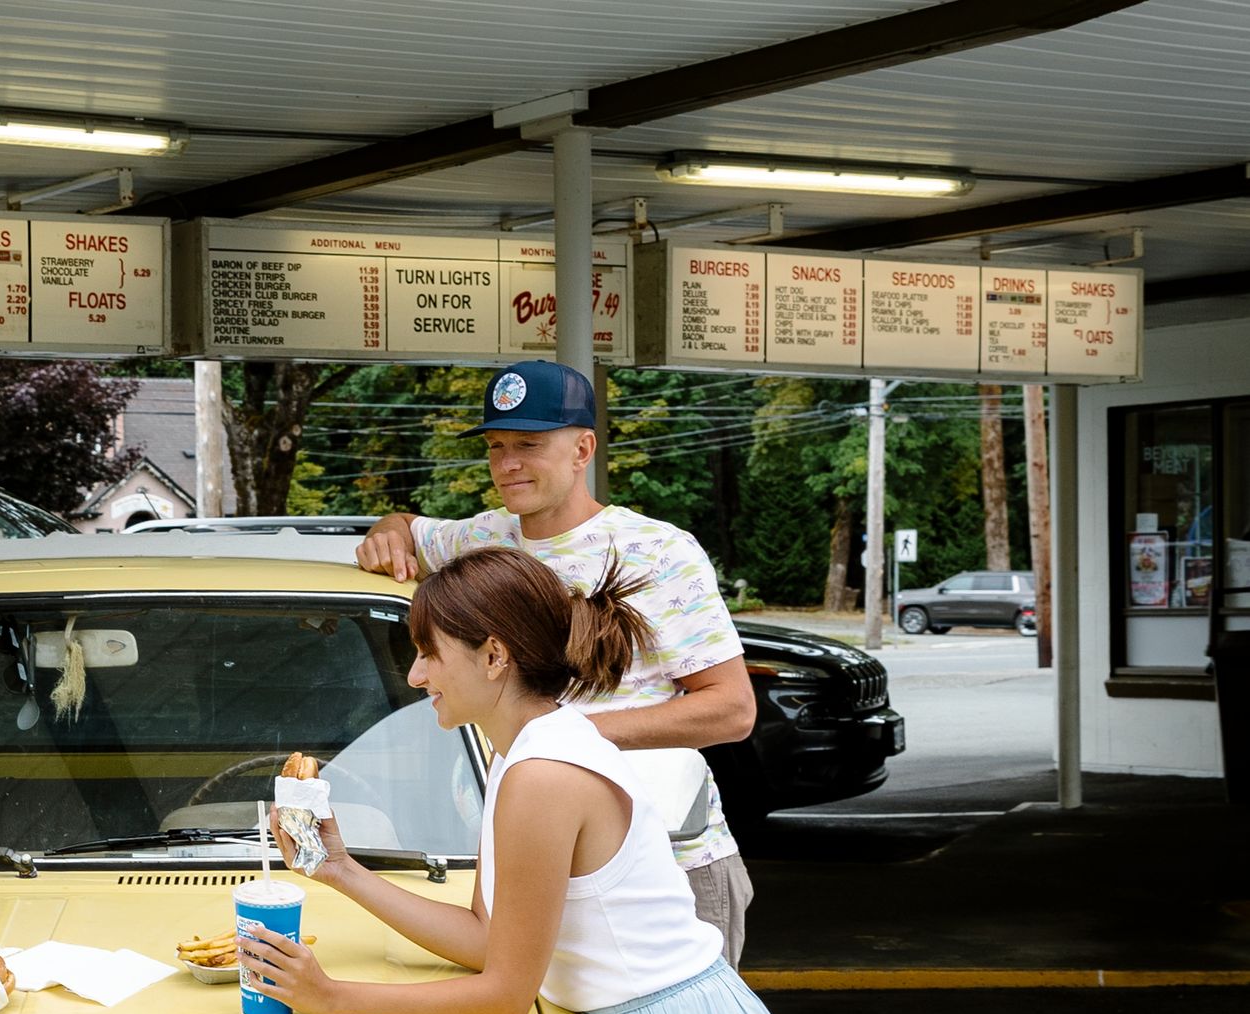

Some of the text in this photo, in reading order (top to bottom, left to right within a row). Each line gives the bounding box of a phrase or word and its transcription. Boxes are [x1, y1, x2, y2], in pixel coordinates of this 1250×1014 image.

[65, 233, 129, 253] SHAKES
[310, 239, 401, 251] ADDITIONAL MENU
[40, 257, 95, 268] STRAWBERRY
[211, 260, 302, 272] BARON OF BEEF DIP
[690, 259, 750, 278] BURGERS
[40, 266, 89, 277] CHOCOLATE
[211, 270, 286, 281] CHICKEN STRIPS
[792, 265, 841, 283] SNACKS
[41, 276, 74, 286] VANILLA
[396, 269, 491, 287] TURN LIGHTS
[892, 271, 955, 289] SEAFOODS
[7, 284, 27, 294] 1.70
[211, 280, 291, 291] CHICKEN BURGER
[993, 277, 1035, 294] DRINKS
[1071, 282, 1116, 298] SHAKES
[7, 295, 27, 305] 2.20
[68, 292, 127, 310] FLOATS
[212, 290, 318, 302] CHICKEN CLUB BURGER
[416, 293, 472, 310] ON FOR
[7, 306, 27, 315] 1.70
[213, 299, 274, 310] SPICEY FRIES
[251, 310, 326, 320] CHICKEN BURGER
[214, 326, 251, 336] POUTINE
[413, 317, 476, 334] SERVICE
[214, 336, 285, 345] APPLE TURNOVER
